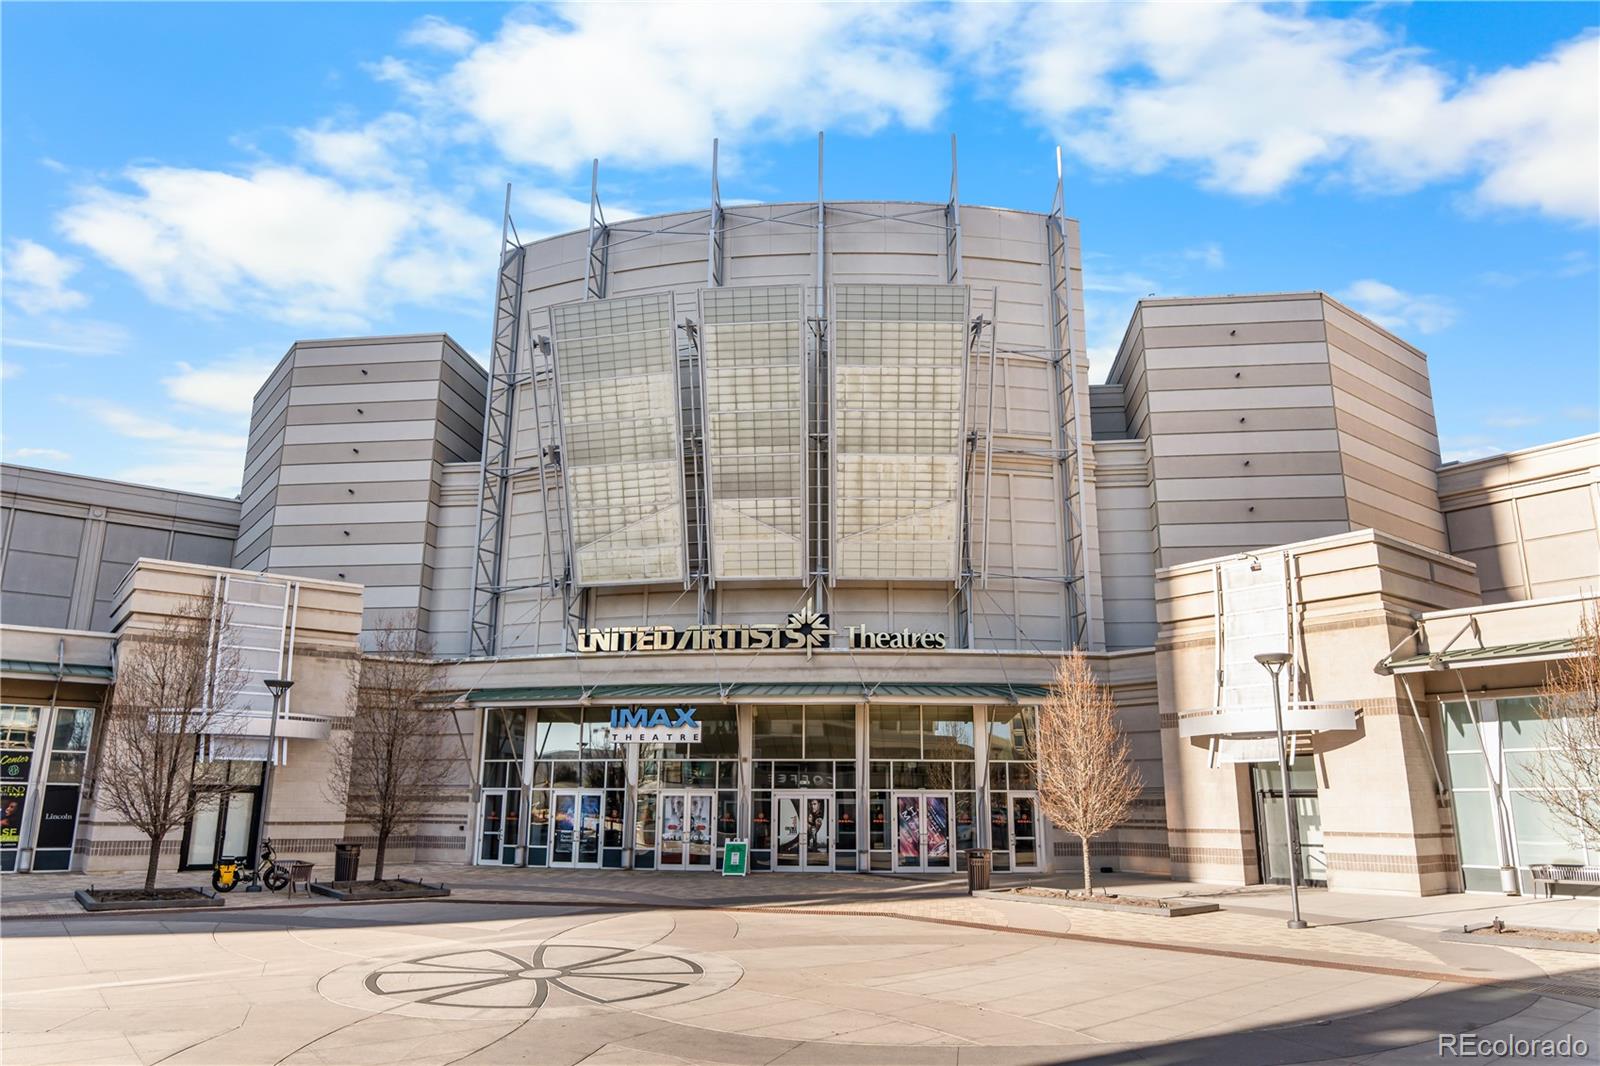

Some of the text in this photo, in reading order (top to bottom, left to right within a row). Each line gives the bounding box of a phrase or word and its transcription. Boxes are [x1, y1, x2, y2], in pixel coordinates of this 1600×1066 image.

[577, 625, 808, 651] UNITED ARTISTS
[844, 623, 946, 649] Theatres
[610, 707, 699, 729] IMAX
[612, 733, 700, 742] THEATRE
